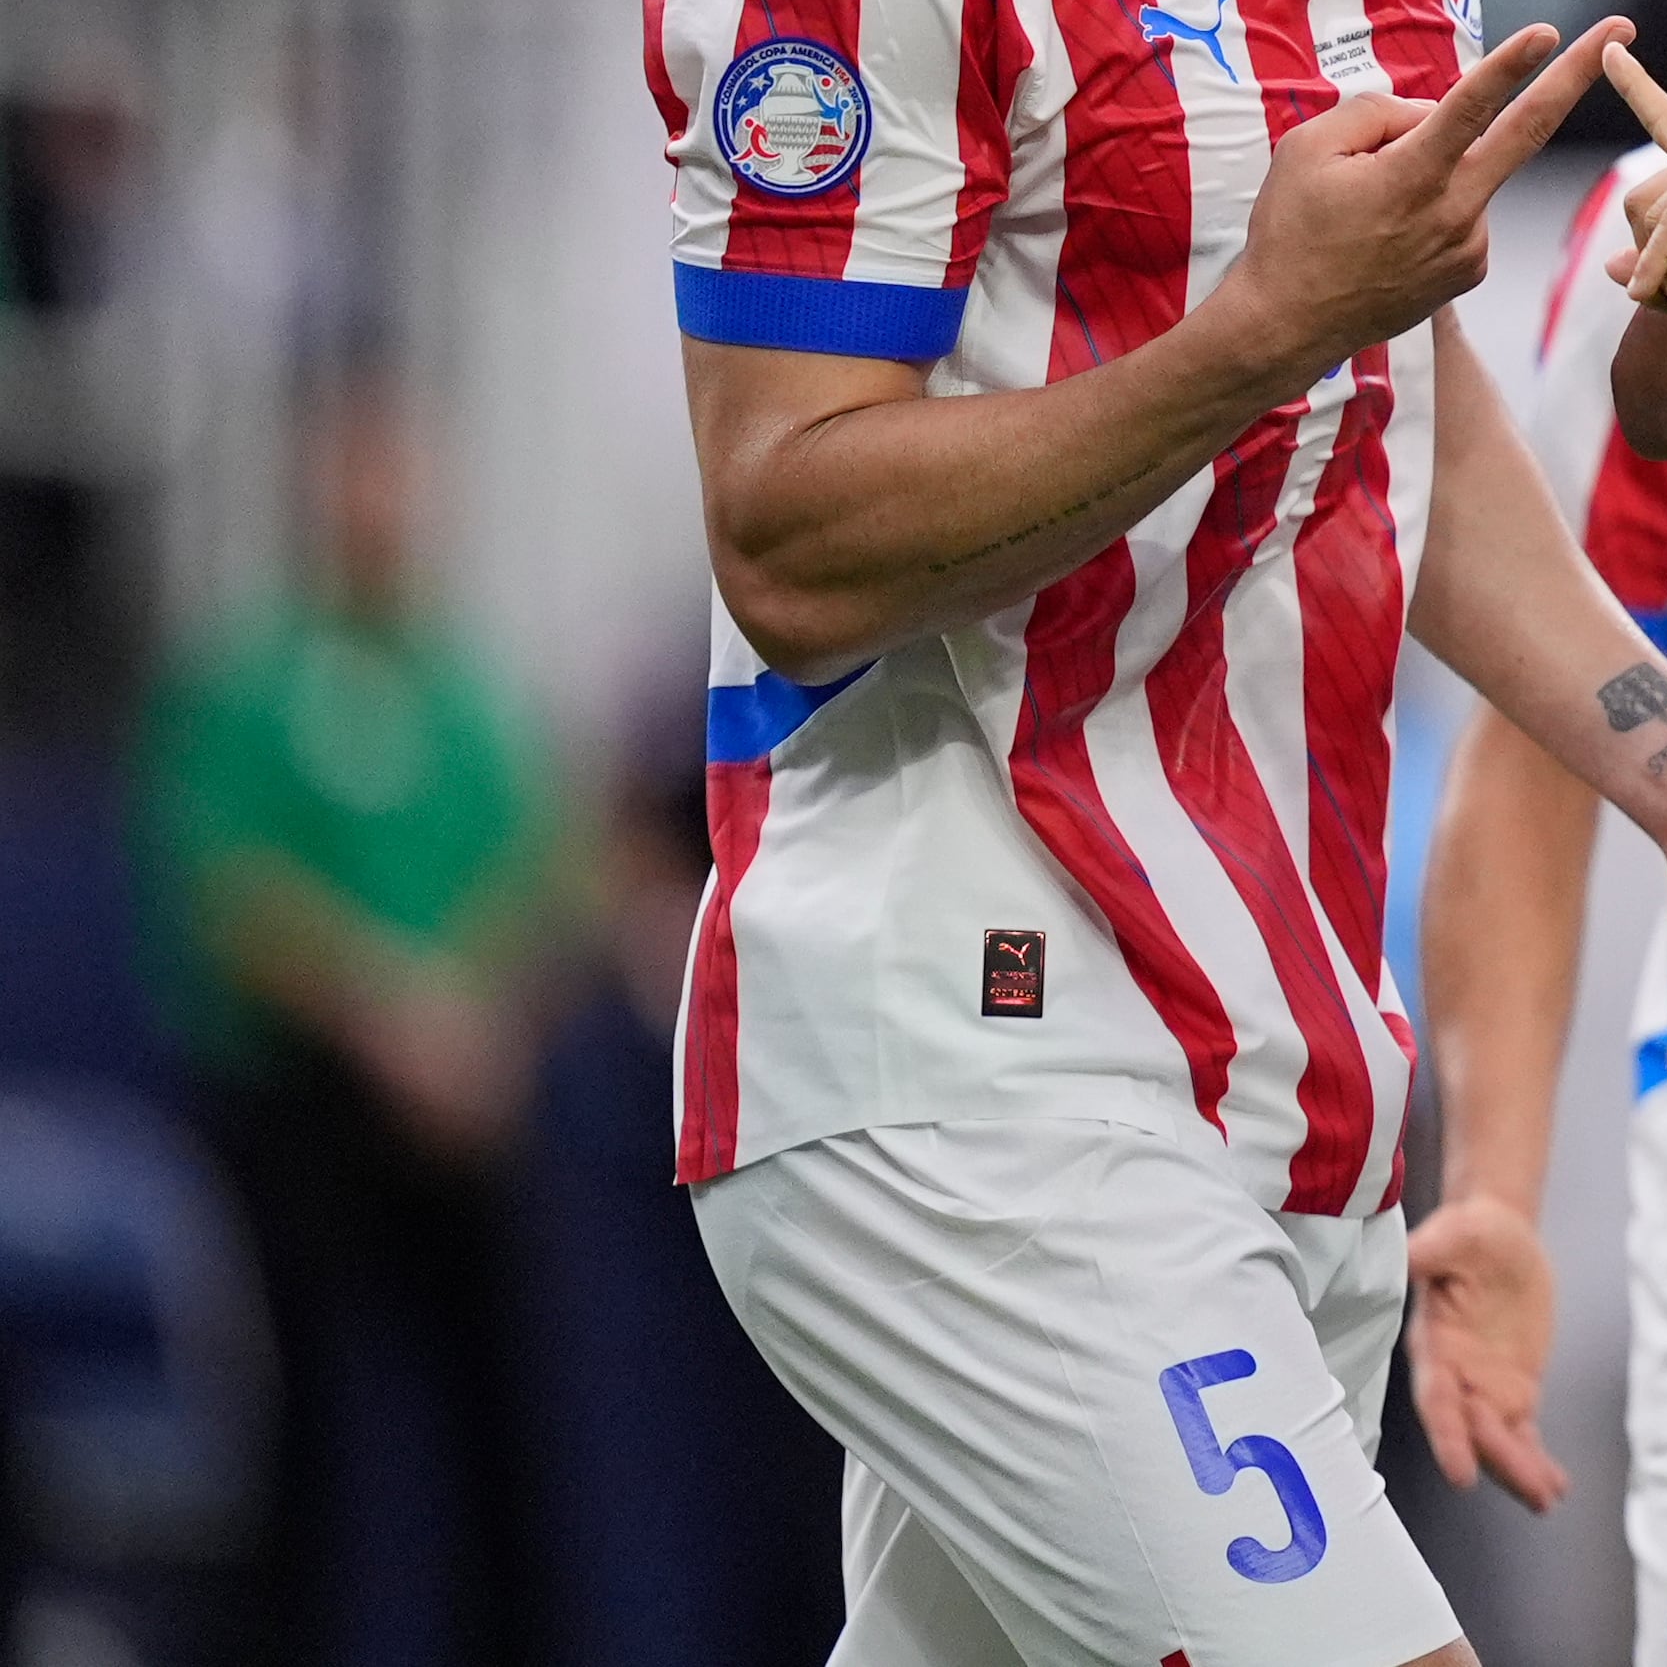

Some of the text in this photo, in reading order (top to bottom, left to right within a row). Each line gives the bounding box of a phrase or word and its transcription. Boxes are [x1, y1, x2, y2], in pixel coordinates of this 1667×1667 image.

[721, 45, 864, 111] CONMEBOL COPA AMERICA USA 2024
[1158, 1348, 1328, 1585] 5
